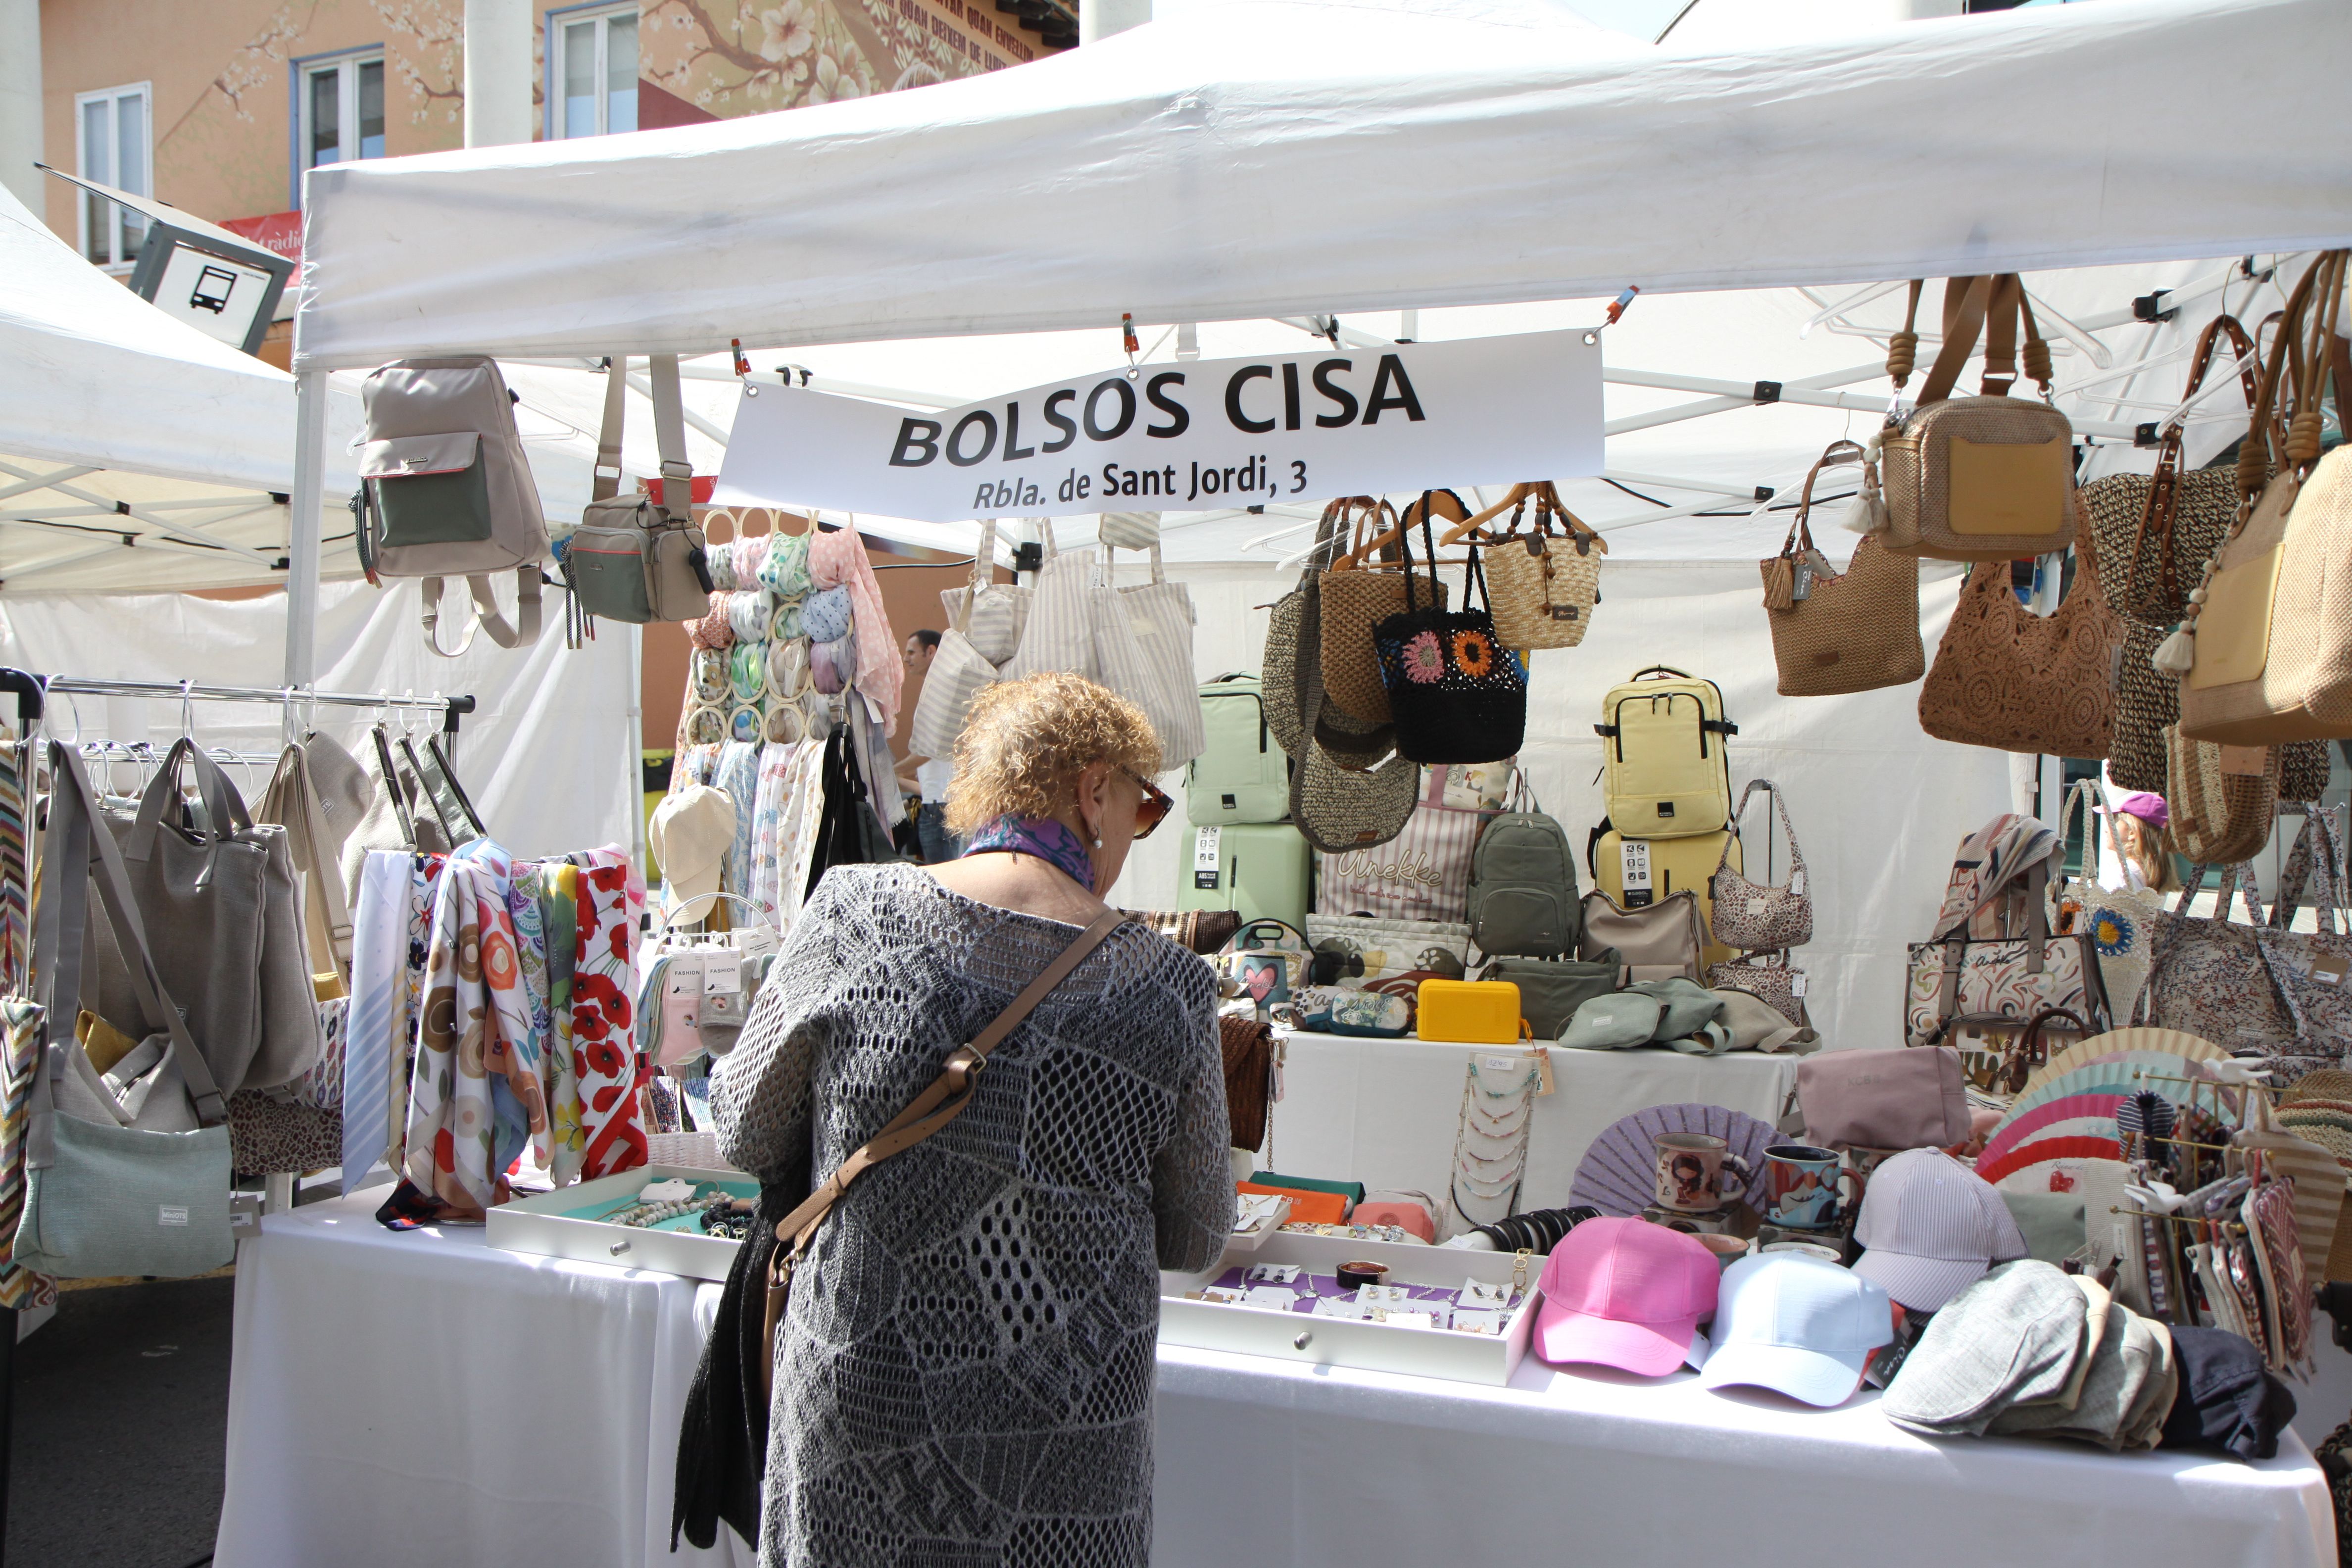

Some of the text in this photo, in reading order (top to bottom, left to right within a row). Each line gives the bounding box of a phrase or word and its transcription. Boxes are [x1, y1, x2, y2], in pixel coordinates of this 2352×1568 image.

[900, 0, 928, 30] QUAN
[932, 15, 966, 54] DEIXEM
[970, 41, 980, 64] DE
[968, 6, 992, 39] QUAN
[889, 354, 1425, 467] BOLSOS CISA
[973, 455, 1306, 509] Rbla. de Sant Jordi, 3
[1280, 1195, 1293, 1204] CB
